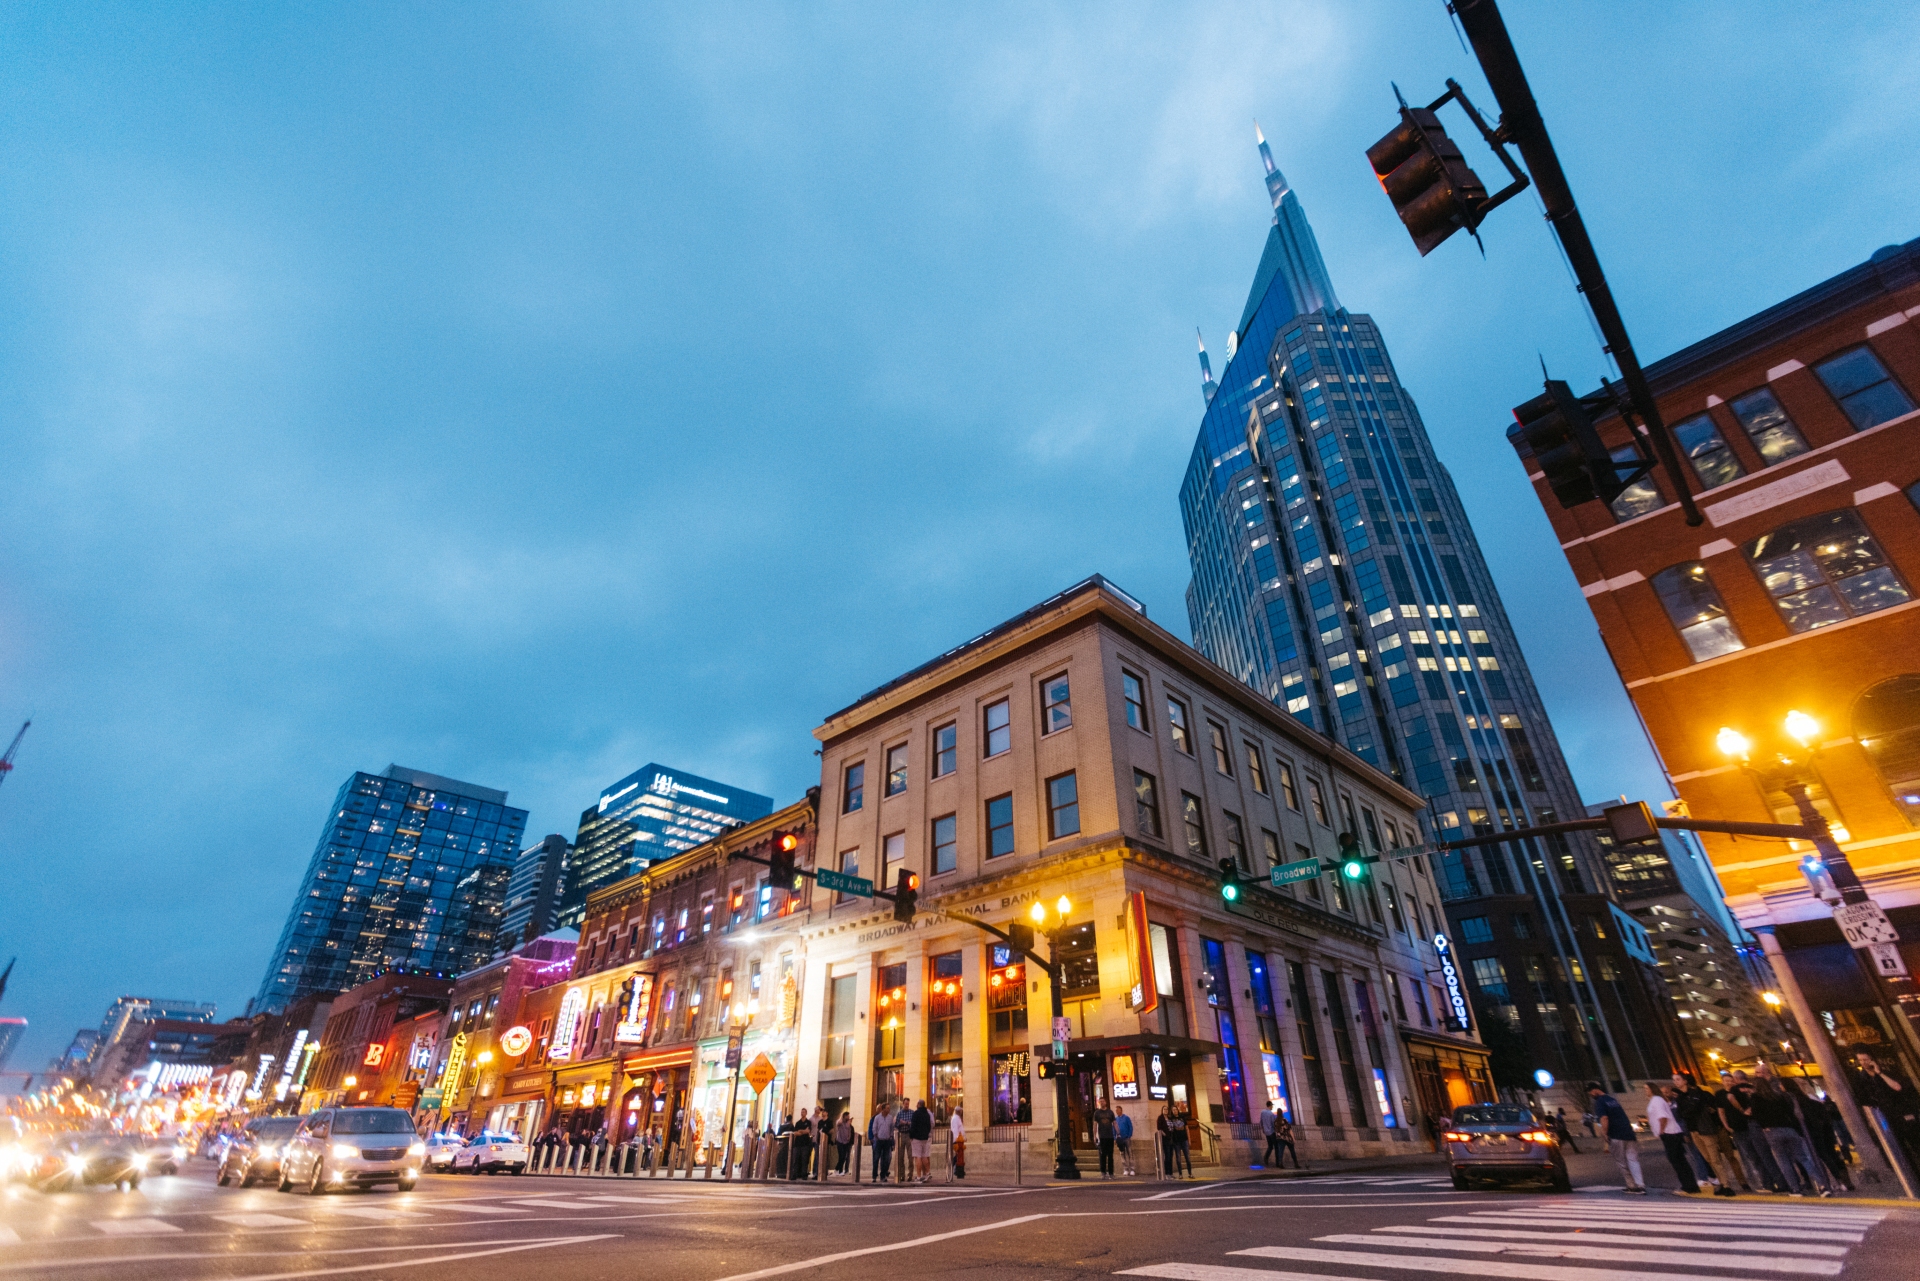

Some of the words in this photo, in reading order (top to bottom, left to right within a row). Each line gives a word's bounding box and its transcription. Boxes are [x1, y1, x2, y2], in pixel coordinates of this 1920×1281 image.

[1389, 845, 1426, 861] PARKING
[1273, 863, 1318, 882] Broadway
[858, 921, 918, 944] BROADWAY
[924, 902, 991, 928] NATNAL
[1001, 889, 1041, 909] BANK
[1253, 910, 1276, 925] OLE
[1276, 917, 1299, 933] RED
[1842, 909, 1879, 925] CROSSING
[1845, 925, 1869, 942] OK
[1441, 955, 1468, 1029] LOOKOUT
[285, 1030, 310, 1075] WHISKEY
[364, 1043, 385, 1066] B
[442, 1051, 462, 1106] VALENTINE
[1113, 1082, 1137, 1091] OLE
[1114, 1090, 1138, 1098] RED
